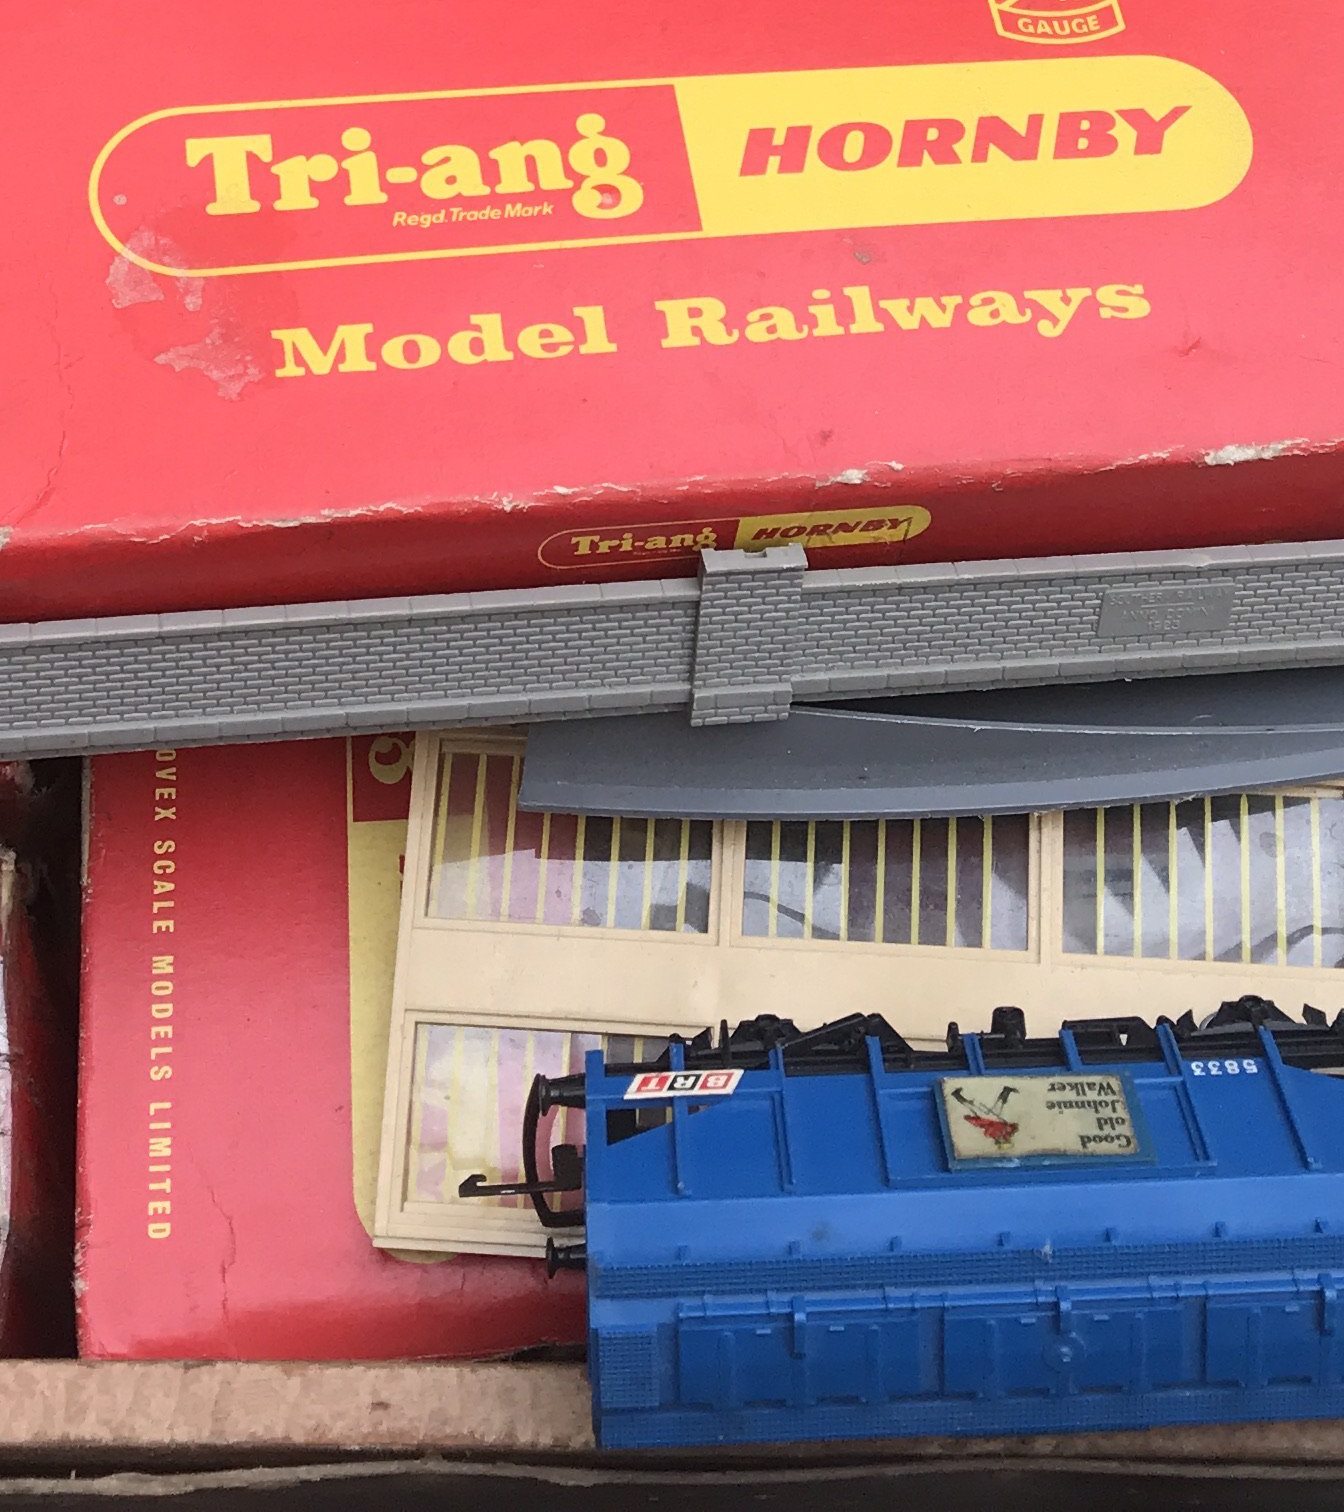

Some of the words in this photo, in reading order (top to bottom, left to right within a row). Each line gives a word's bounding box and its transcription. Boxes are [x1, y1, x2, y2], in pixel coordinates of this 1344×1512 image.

[1017, 13, 1100, 35] GAUGE
[739, 106, 1193, 177] HORNBY
[185, 113, 644, 218] Tri-ang
[504, 201, 554, 219] Mark
[272, 306, 618, 378] Model
[655, 283, 1151, 348] Railways
[752, 516, 914, 541] HORNBY
[572, 527, 717, 556] Tri-ang
[154, 747, 177, 821] OVEX
[152, 840, 175, 934] SCALE
[150, 955, 174, 1081] MODELS
[1191, 1059, 1258, 1075] 5833
[638, 1071, 737, 1094] BRT
[1048, 1079, 1117, 1096] Walker
[1047, 1097, 1123, 1114] Johnnie
[1096, 1114, 1127, 1132] old
[1080, 1133, 1131, 1150] Good
[148, 1101, 172, 1240] LIMITED
